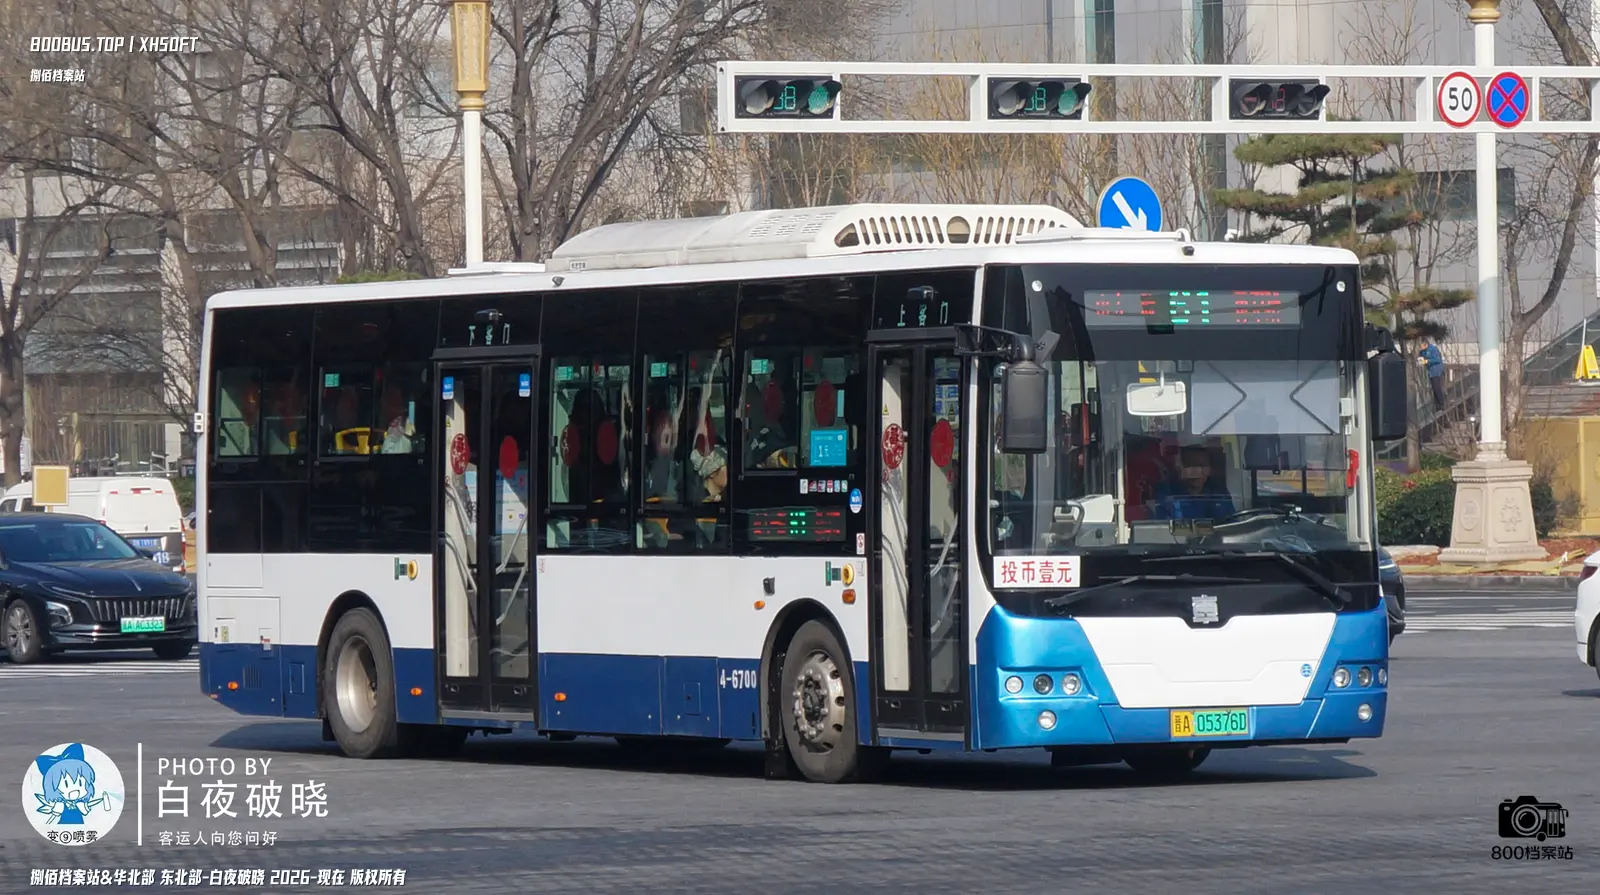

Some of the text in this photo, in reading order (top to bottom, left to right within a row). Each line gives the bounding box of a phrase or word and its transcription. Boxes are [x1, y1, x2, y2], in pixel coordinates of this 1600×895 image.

[1447, 86, 1473, 112] 50
[1000, 560, 1073, 585] 投币壹元
[720, 669, 757, 689] 4-6700
[1174, 712, 1247, 733] 晋A 05376D
